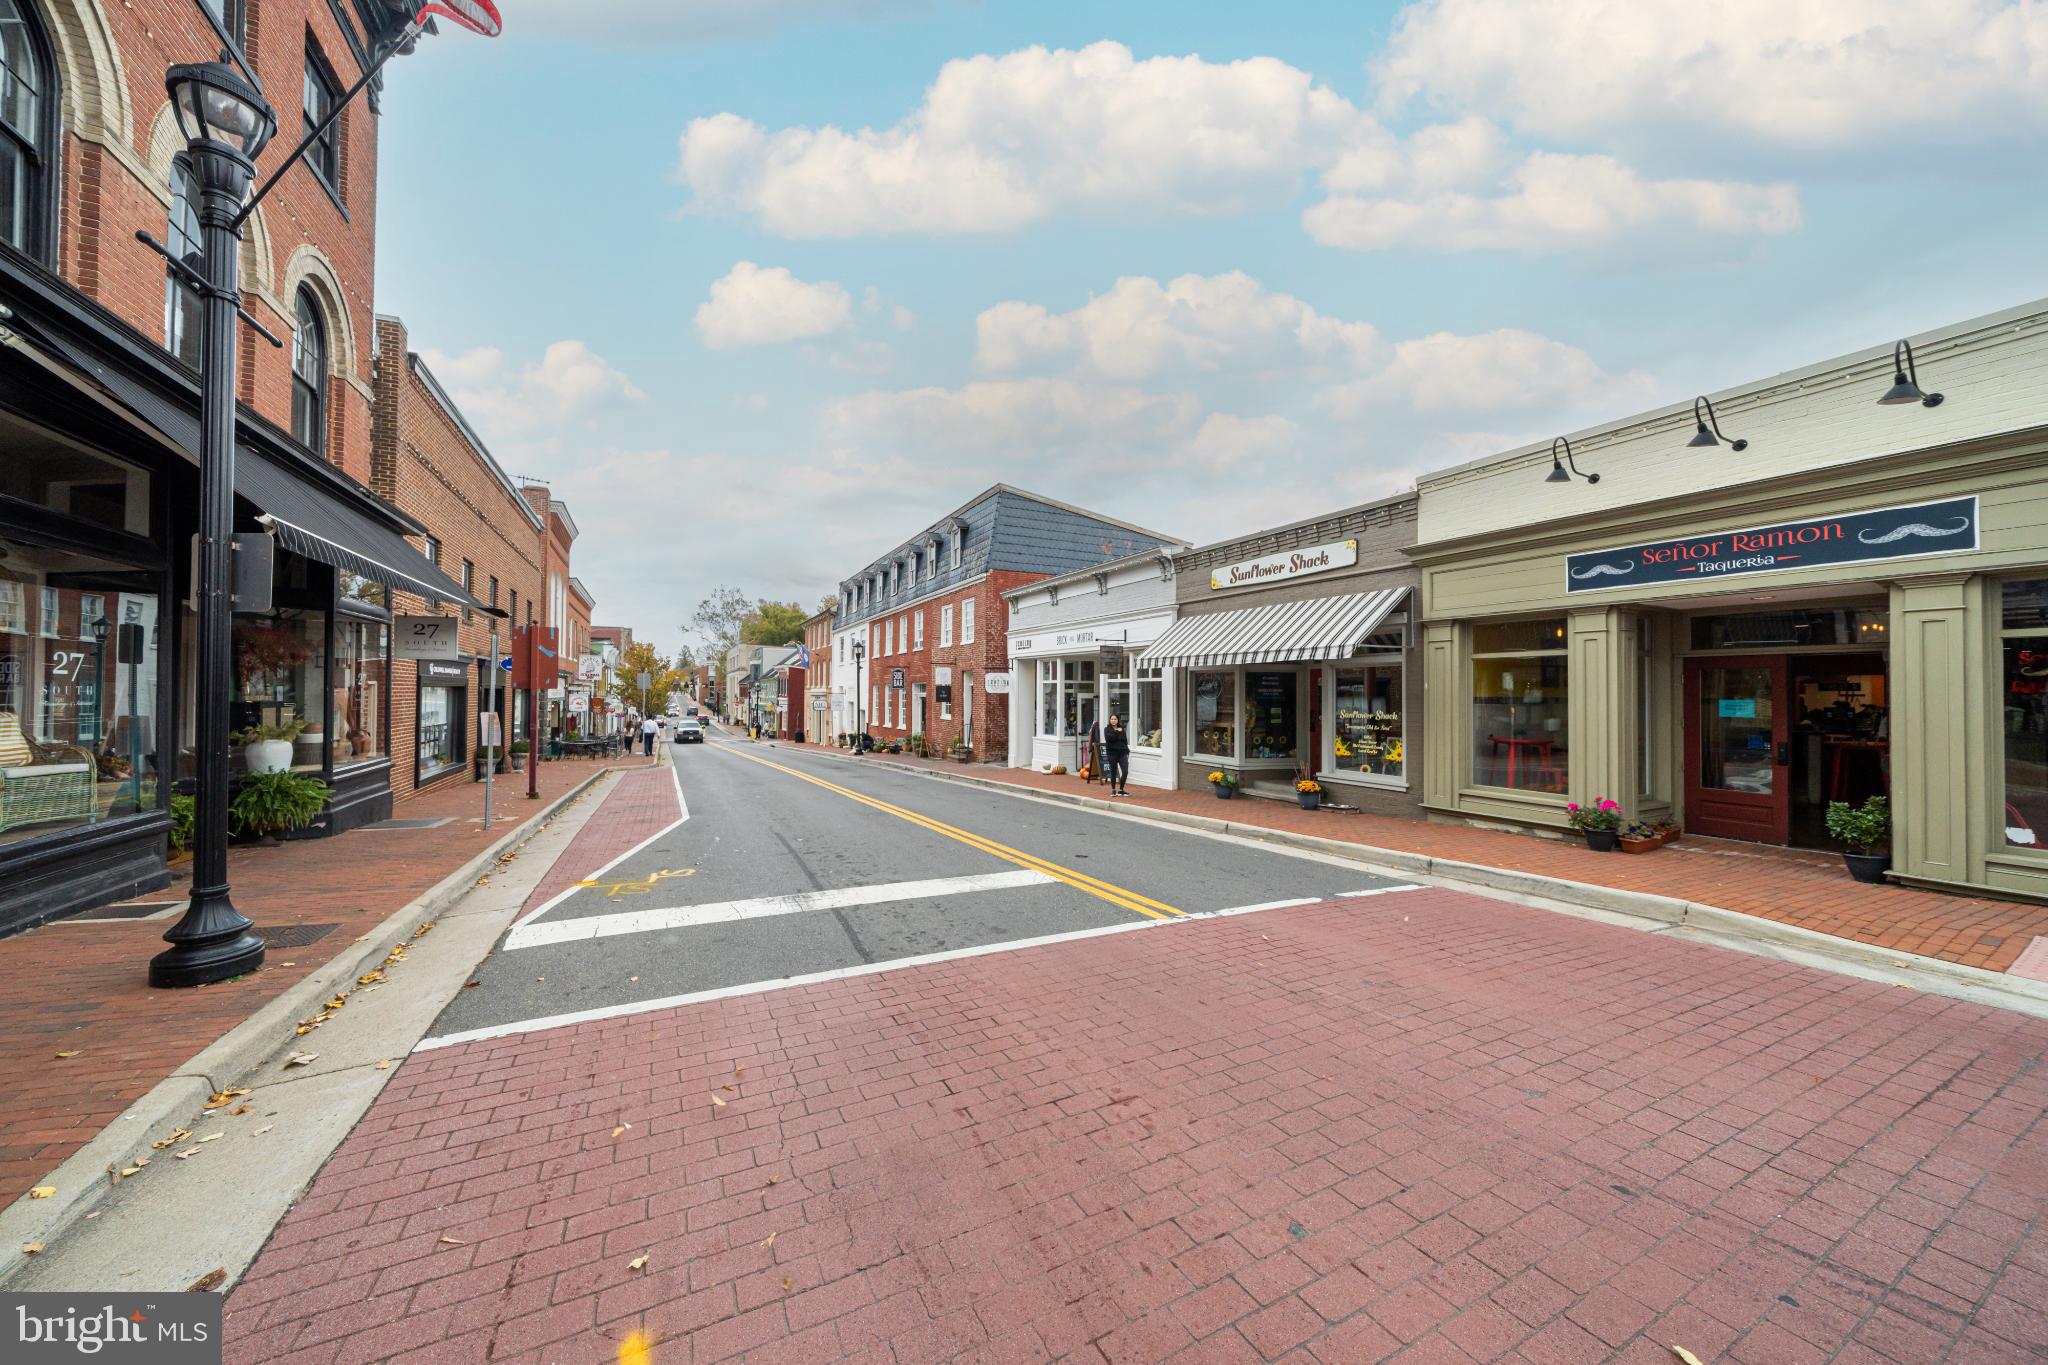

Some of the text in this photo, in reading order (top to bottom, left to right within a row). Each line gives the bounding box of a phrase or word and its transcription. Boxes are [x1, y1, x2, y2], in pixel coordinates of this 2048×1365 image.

[1643, 523, 1845, 565] Señor Ramon
[1230, 551, 1330, 583] Sunflower Shack
[1697, 555, 1775, 574] Taqueria
[413, 623, 440, 639] 27
[52, 651, 85, 682] 27
[40, 685, 93, 695] SOUTH
[893, 679, 904, 687] BAR
